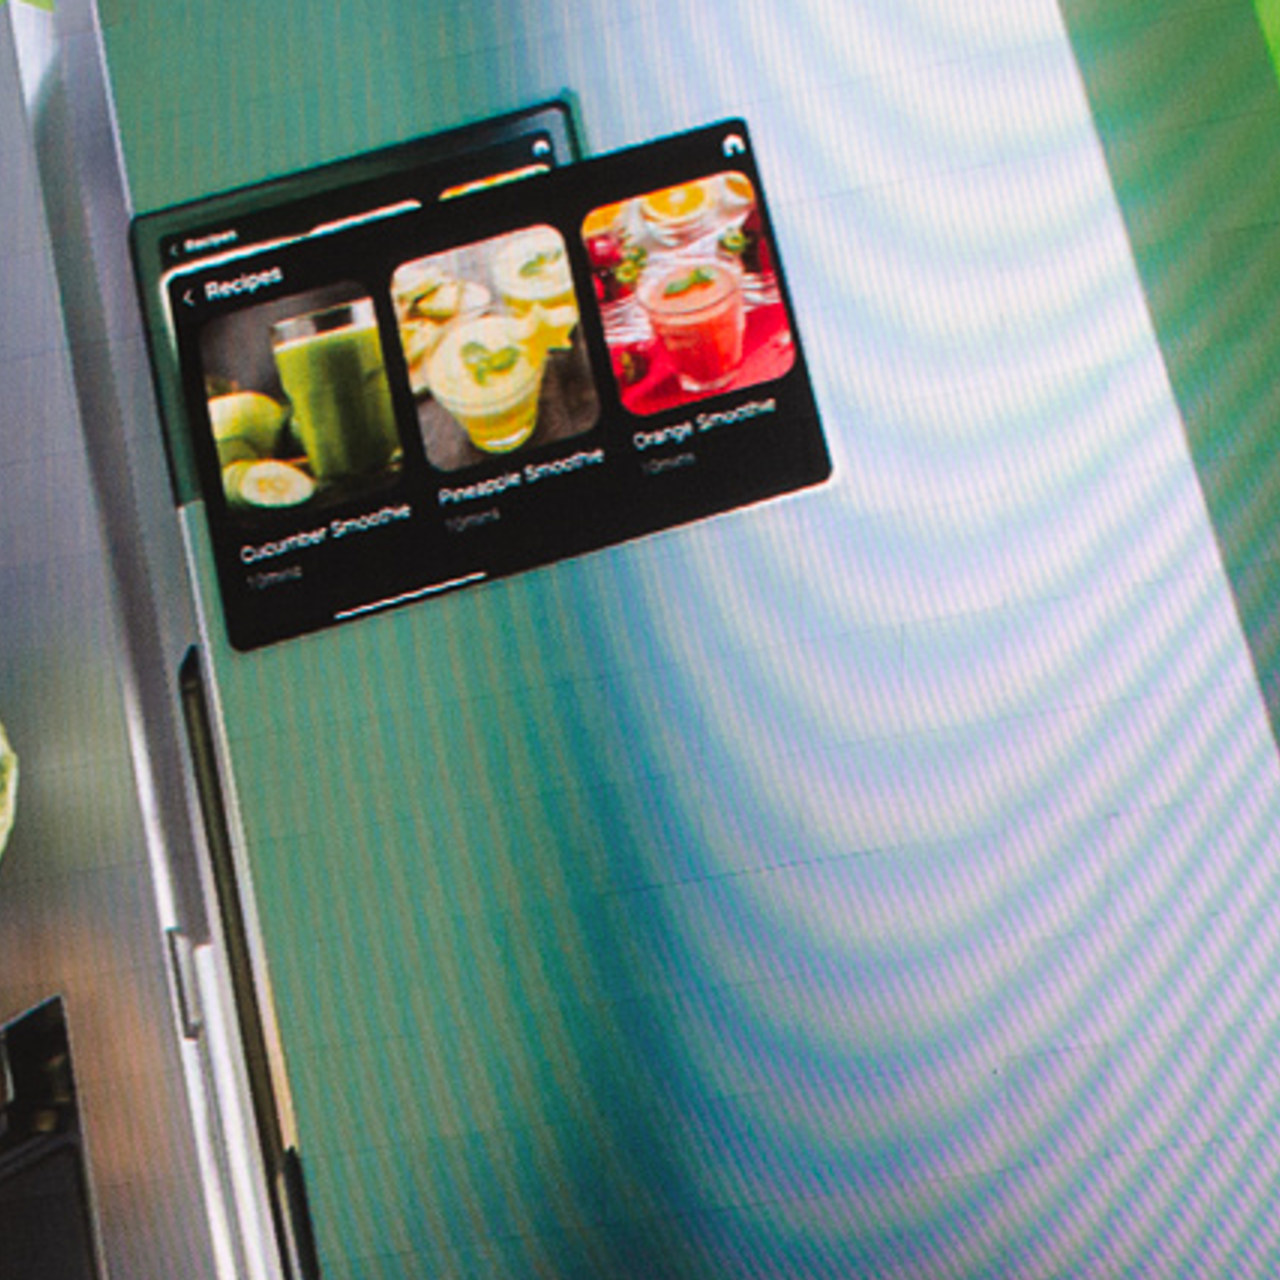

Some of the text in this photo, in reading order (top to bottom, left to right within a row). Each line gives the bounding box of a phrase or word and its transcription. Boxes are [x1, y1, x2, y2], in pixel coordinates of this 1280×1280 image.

[204, 266, 283, 300] Recipes
[633, 398, 777, 450] Orange Smoothie
[437, 448, 605, 506] Pineapple Smoothie
[240, 503, 412, 564] Cucumber Smoothie
